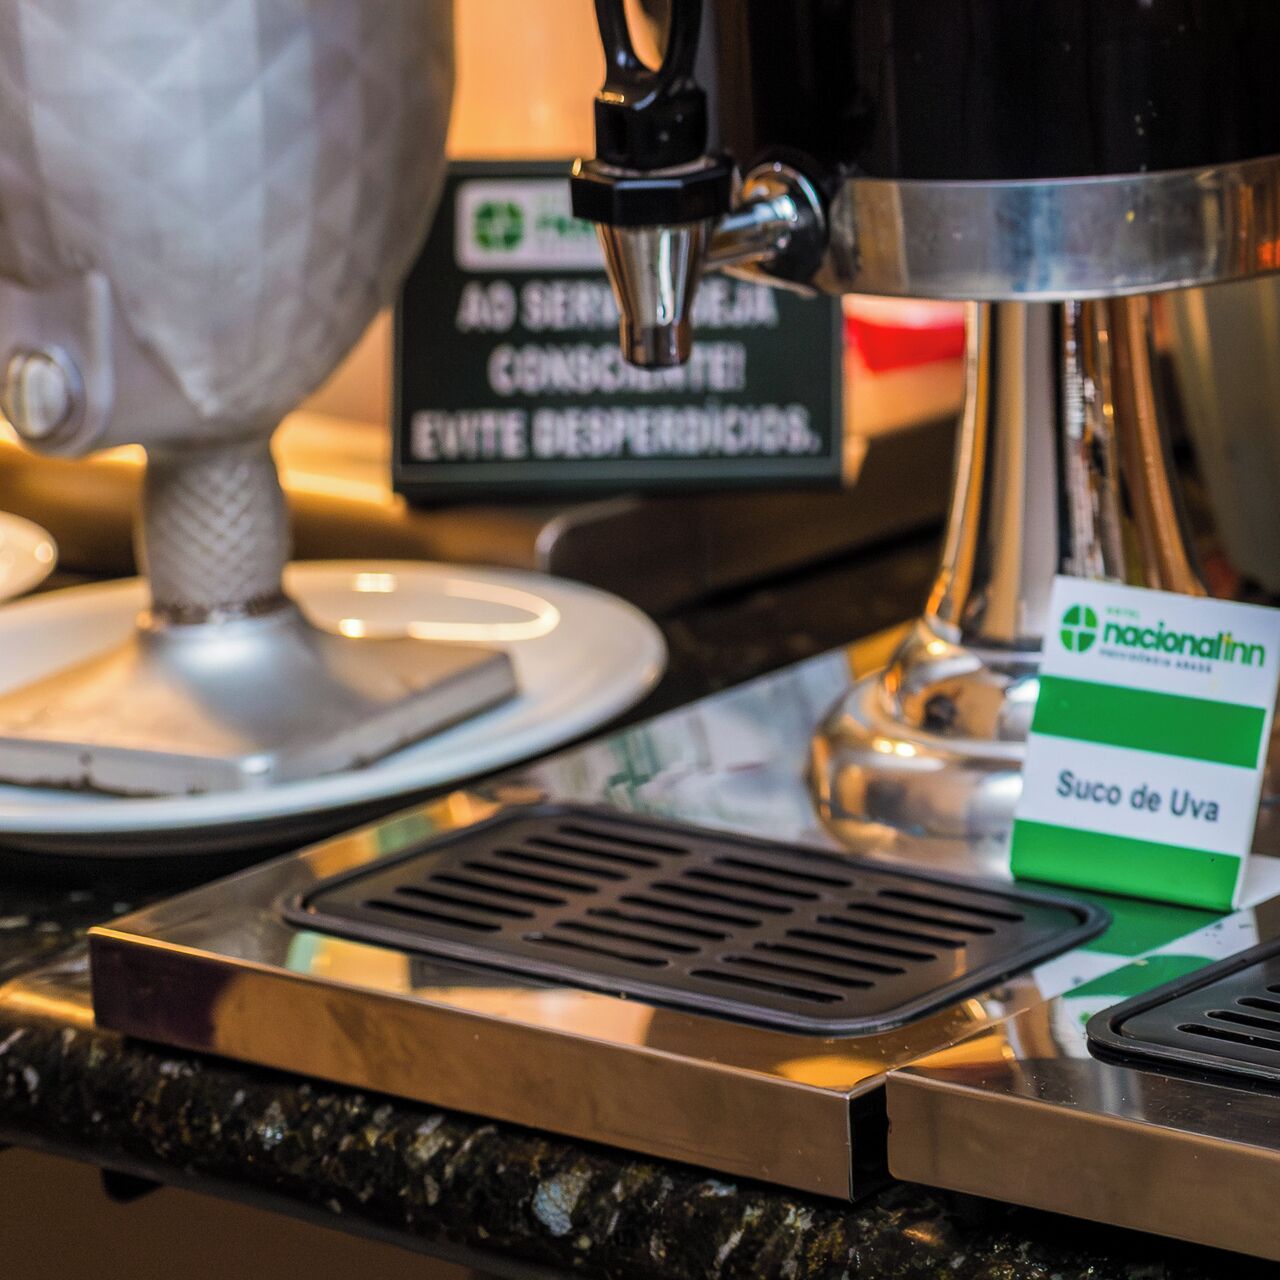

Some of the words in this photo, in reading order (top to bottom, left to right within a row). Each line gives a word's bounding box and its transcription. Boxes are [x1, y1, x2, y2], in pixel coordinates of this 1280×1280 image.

[458, 280, 516, 332] AO
[520, 279, 618, 332] SERV
[690, 276, 780, 329] EJA
[411, 409, 527, 461] EVITE
[1056, 769, 1121, 806] Suco
[1130, 783, 1161, 812] de
[1170, 788, 1219, 822] Uva
